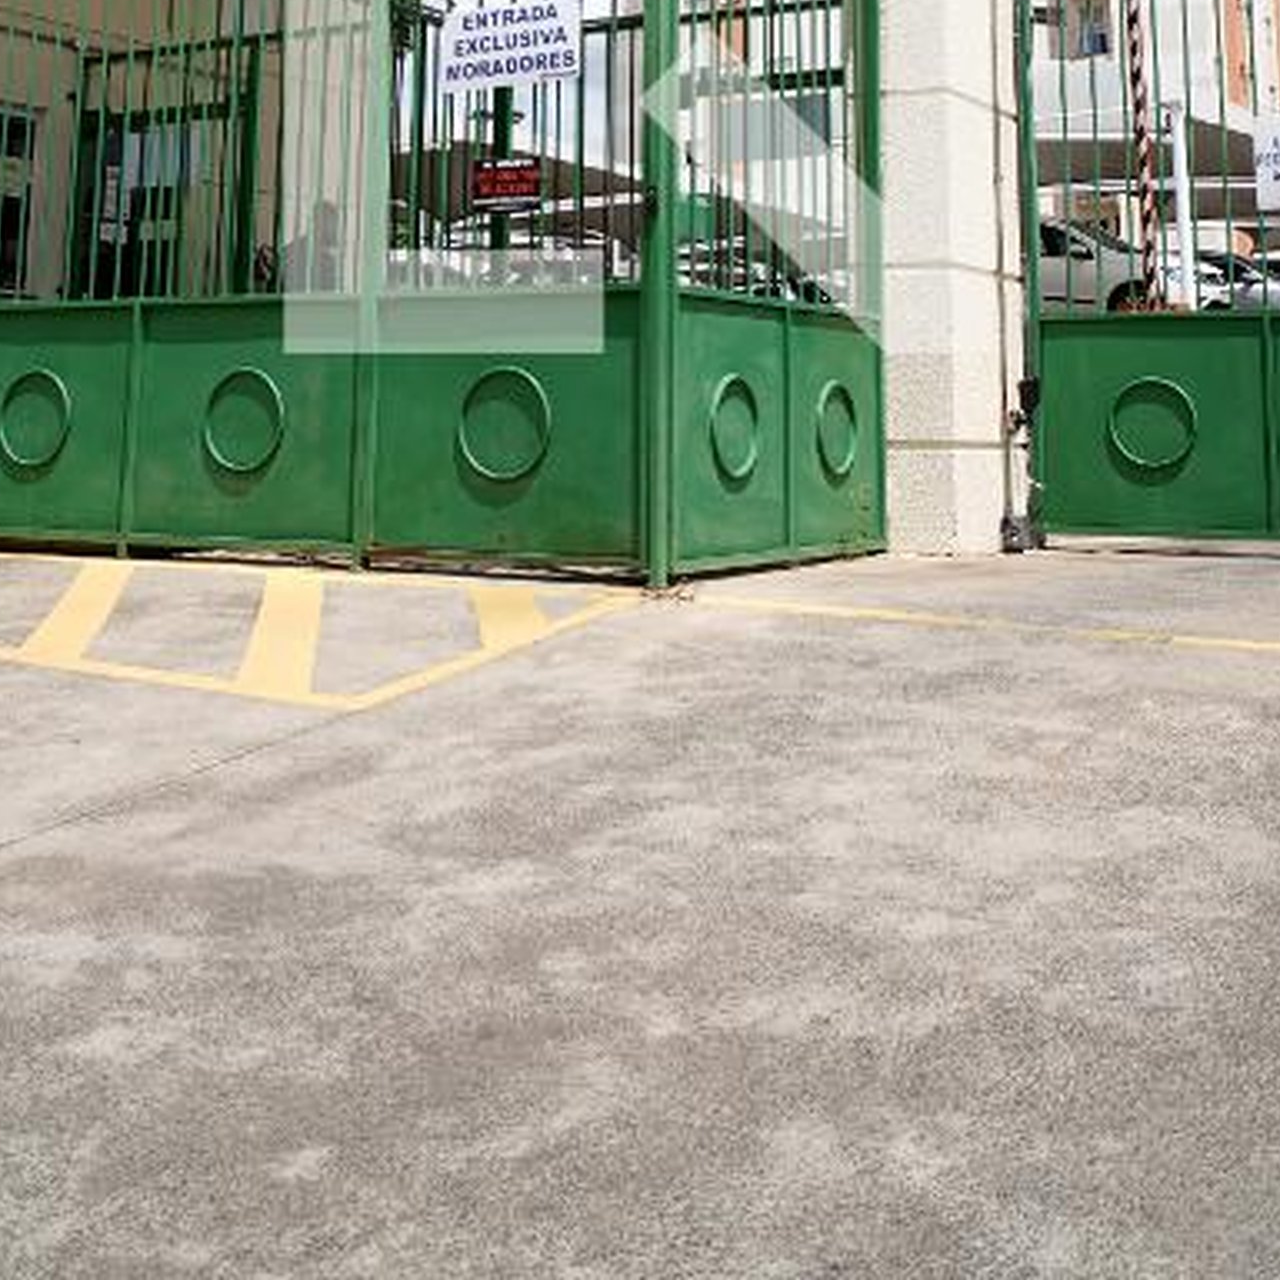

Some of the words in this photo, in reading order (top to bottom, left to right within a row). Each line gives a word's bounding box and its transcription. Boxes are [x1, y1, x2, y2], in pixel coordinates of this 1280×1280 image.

[462, 3, 559, 31] ENTRADA
[454, 26, 568, 57] EXCLUSIVA
[446, 49, 577, 81] MORADORES
